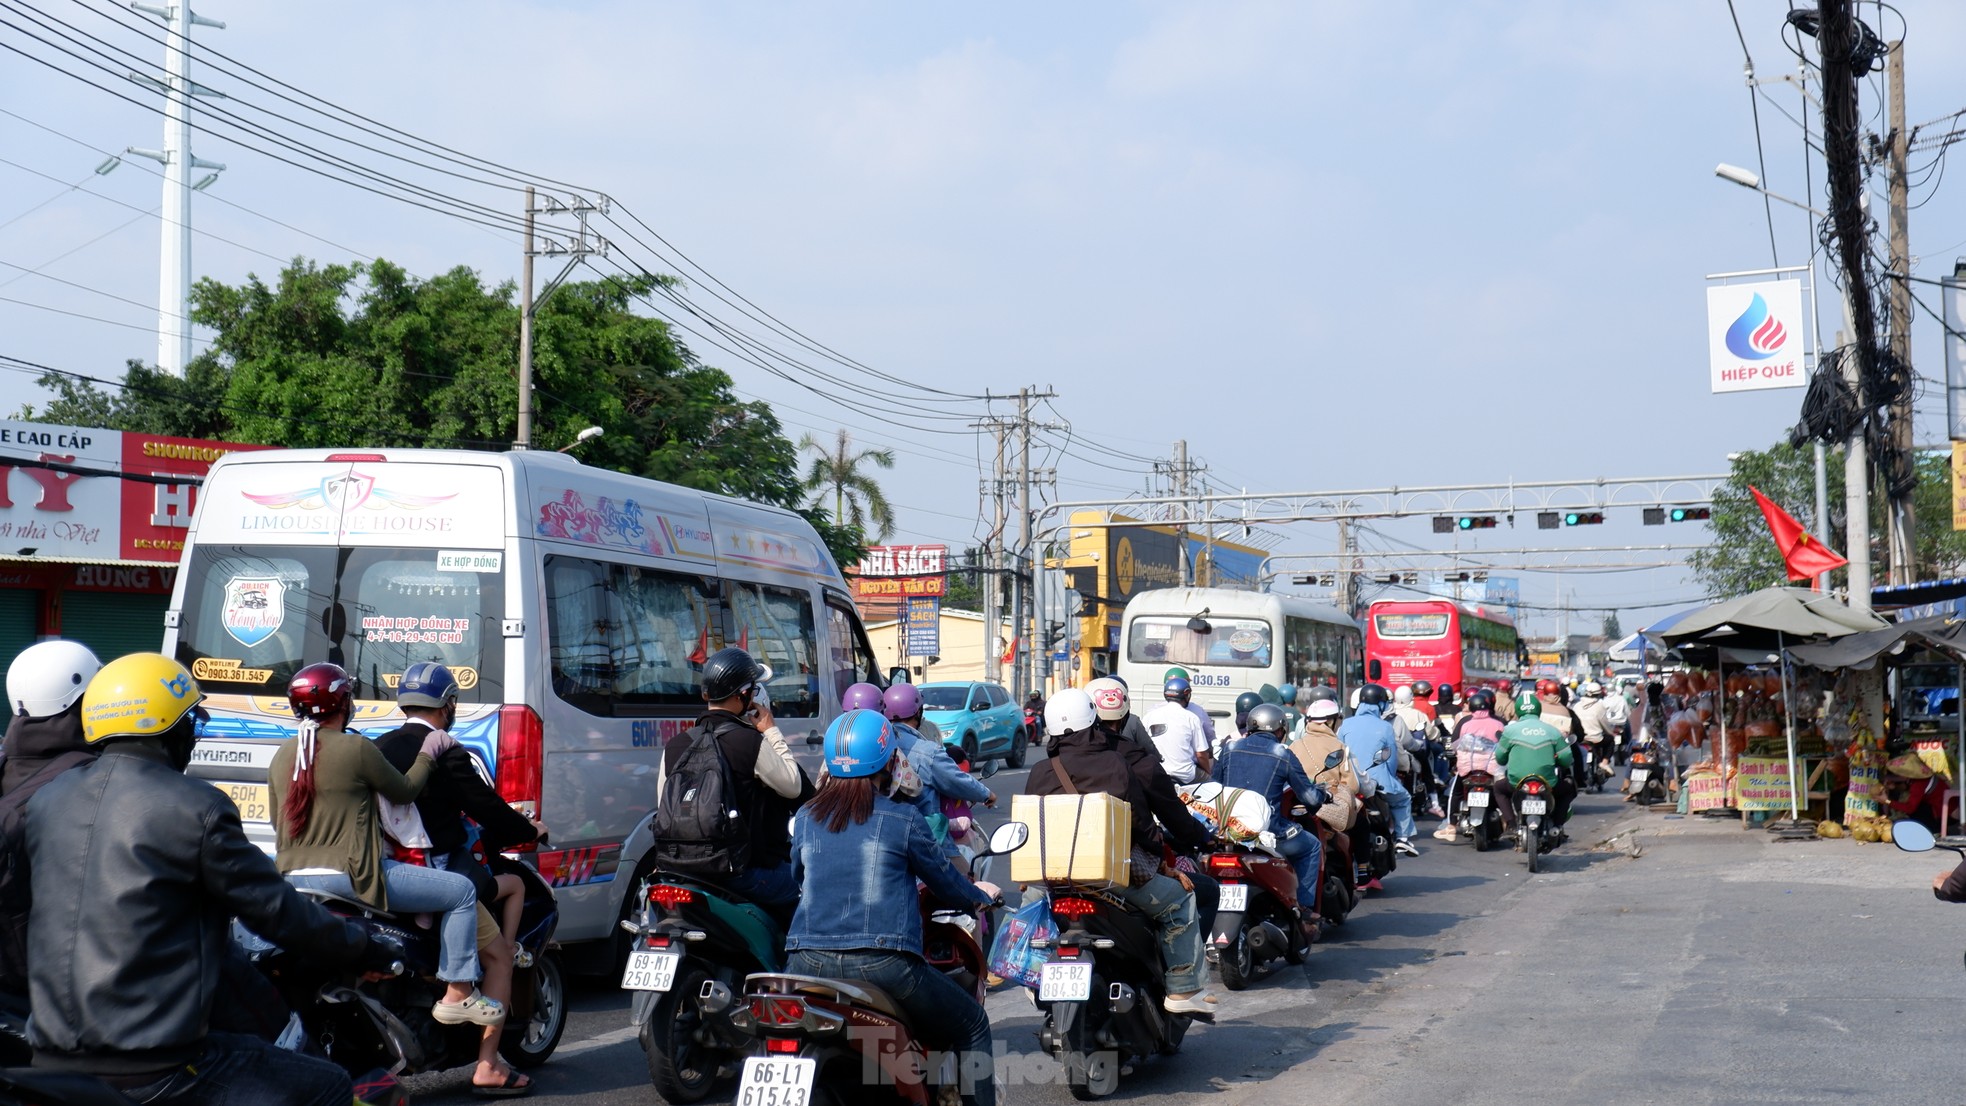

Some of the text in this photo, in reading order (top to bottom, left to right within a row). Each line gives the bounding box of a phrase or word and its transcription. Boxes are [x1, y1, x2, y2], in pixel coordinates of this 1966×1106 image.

[1762, 361, 1795, 378] QUẾ
[17, 431, 51, 446] CAO
[58, 430, 92, 449] CẤP
[143, 441, 235, 462] SHOWROO
[241, 515, 453, 532] LIMOUSINE HOUSE
[441, 556, 452, 567] XE
[454, 557, 471, 569] HỢP
[859, 545, 942, 576] NHÀ SÁCH
[241, 582, 251, 590] DU
[363, 615, 394, 631] NHẬN
[396, 617, 418, 631] HỢP
[453, 618, 469, 630] XE
[367, 631, 436, 643] 4-7-16-29-45
[208, 668, 265, 682] 0903.361.545
[160, 673, 191, 699] be
[1521, 728, 1546, 737] Grab
[193, 750, 251, 763] HYUNDAI
[231, 786, 257, 801] 60H
[634, 954, 670, 971] 69-M1
[625, 971, 671, 988] 250.58
[1049, 966, 1084, 980] 35-B2
[852, 1011, 890, 1027] VISION
[753, 1063, 802, 1084] 66-L1
[743, 1086, 806, 1106] 615.43
